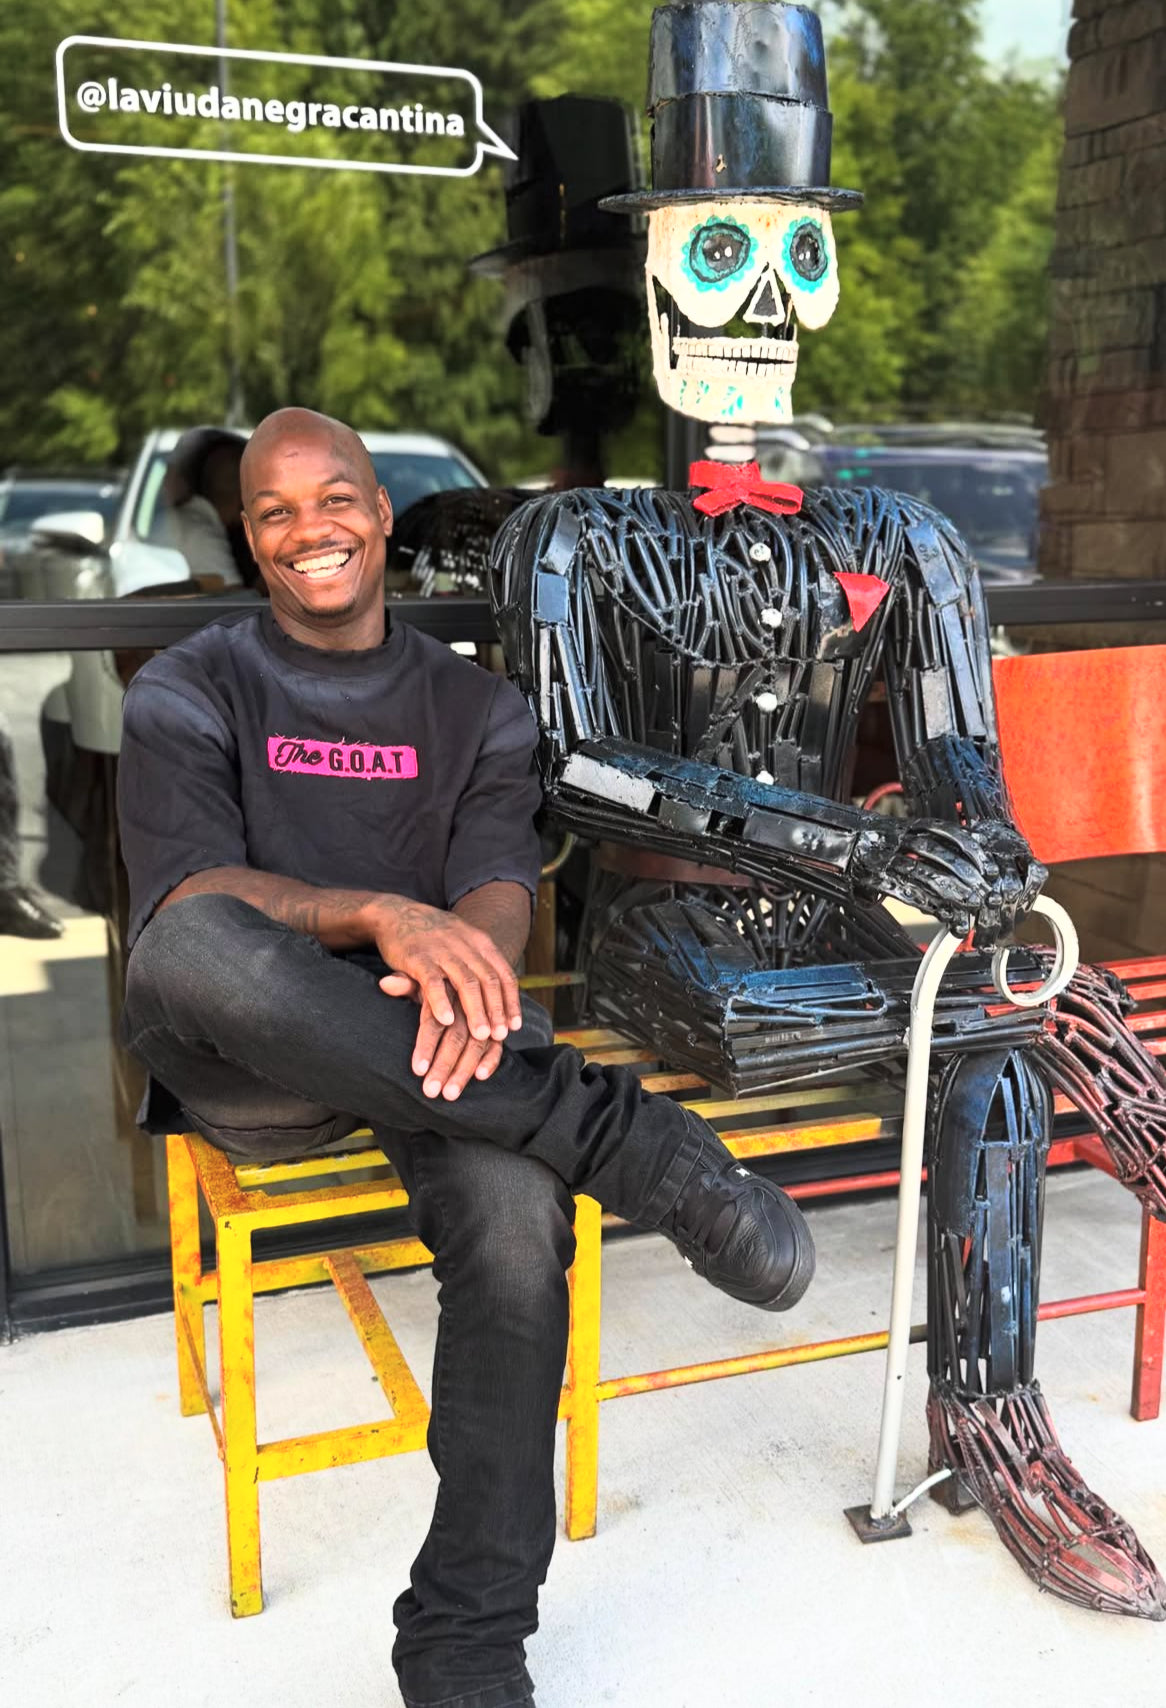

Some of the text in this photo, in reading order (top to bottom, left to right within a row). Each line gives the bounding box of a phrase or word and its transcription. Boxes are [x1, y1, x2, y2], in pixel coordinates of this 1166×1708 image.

[77, 78, 465, 136] @laviudanegracantina
[275, 741, 403, 773] The G.O.A.T
